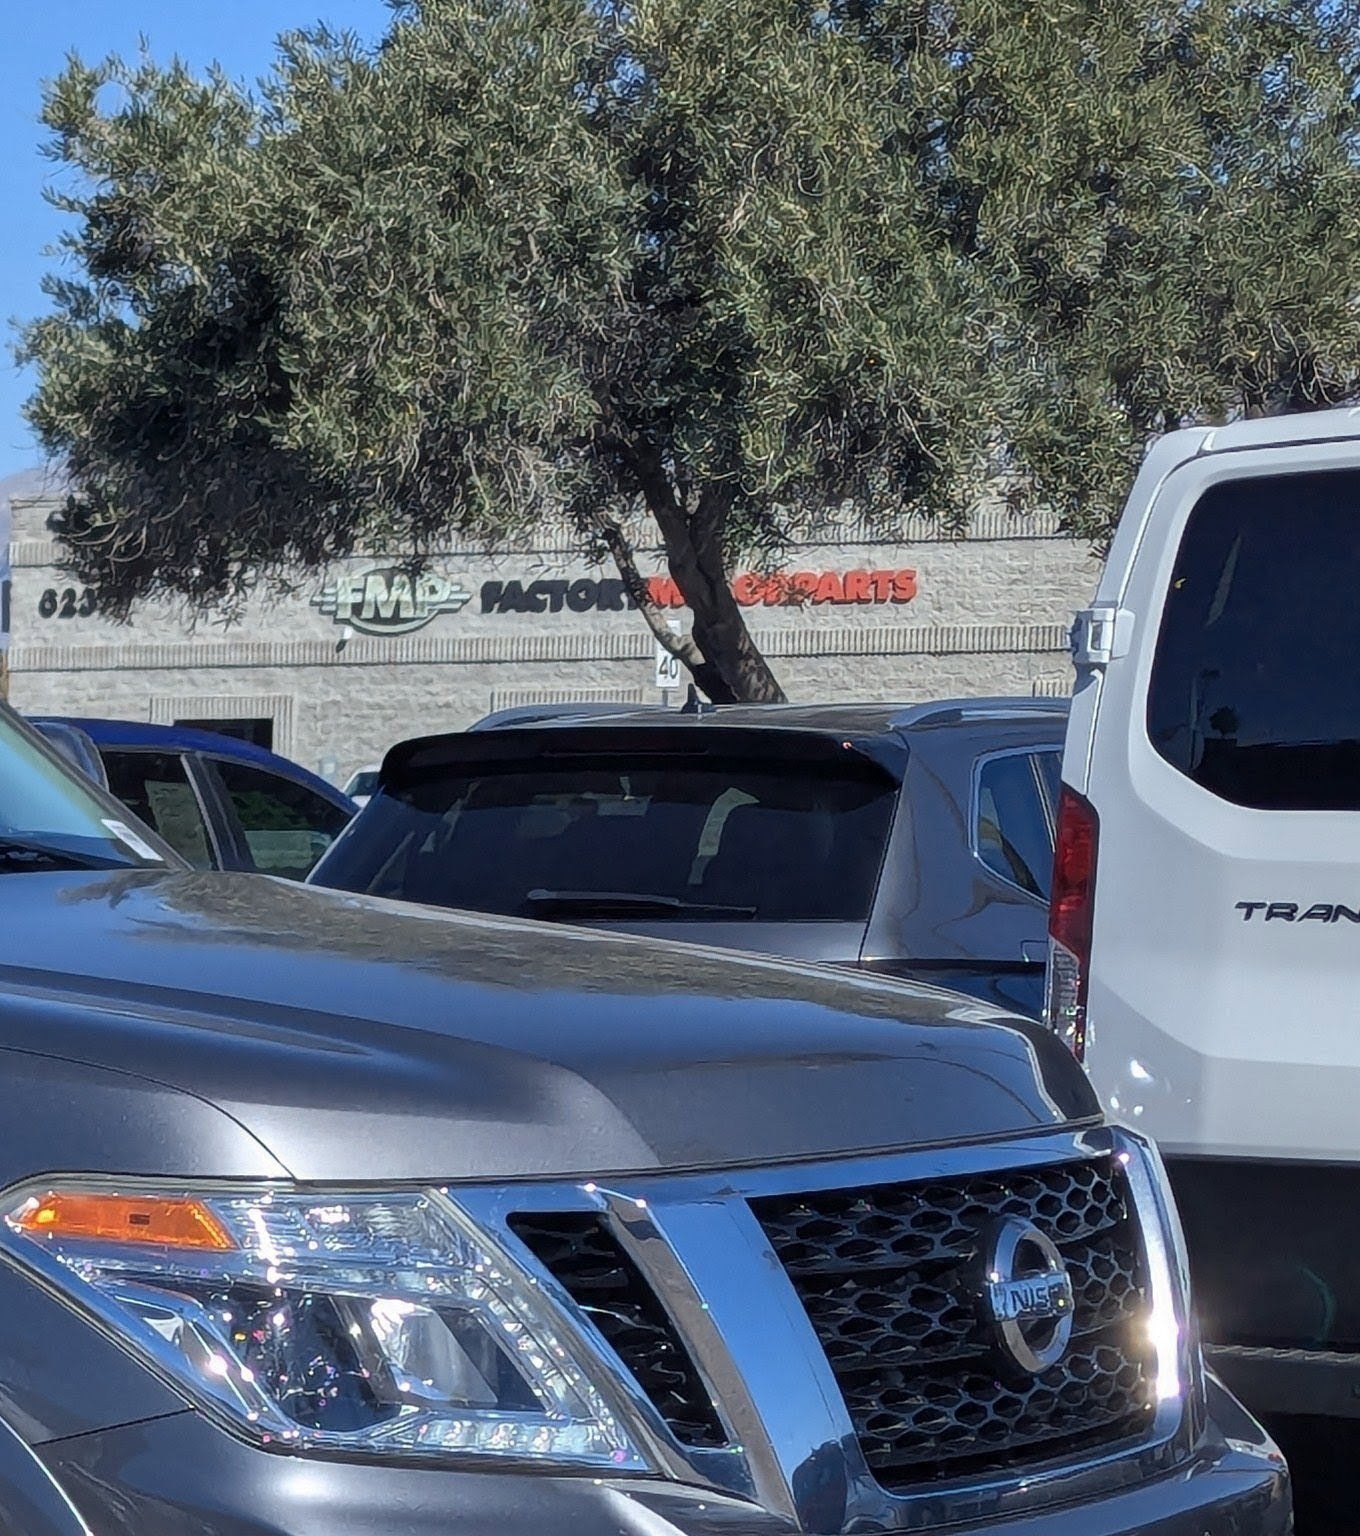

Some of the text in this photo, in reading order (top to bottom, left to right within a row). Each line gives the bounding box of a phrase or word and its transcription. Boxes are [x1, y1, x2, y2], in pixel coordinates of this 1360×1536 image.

[335, 572, 452, 620] FMP
[658, 655, 679, 680] 40
[1234, 901, 1360, 923] TRAN
